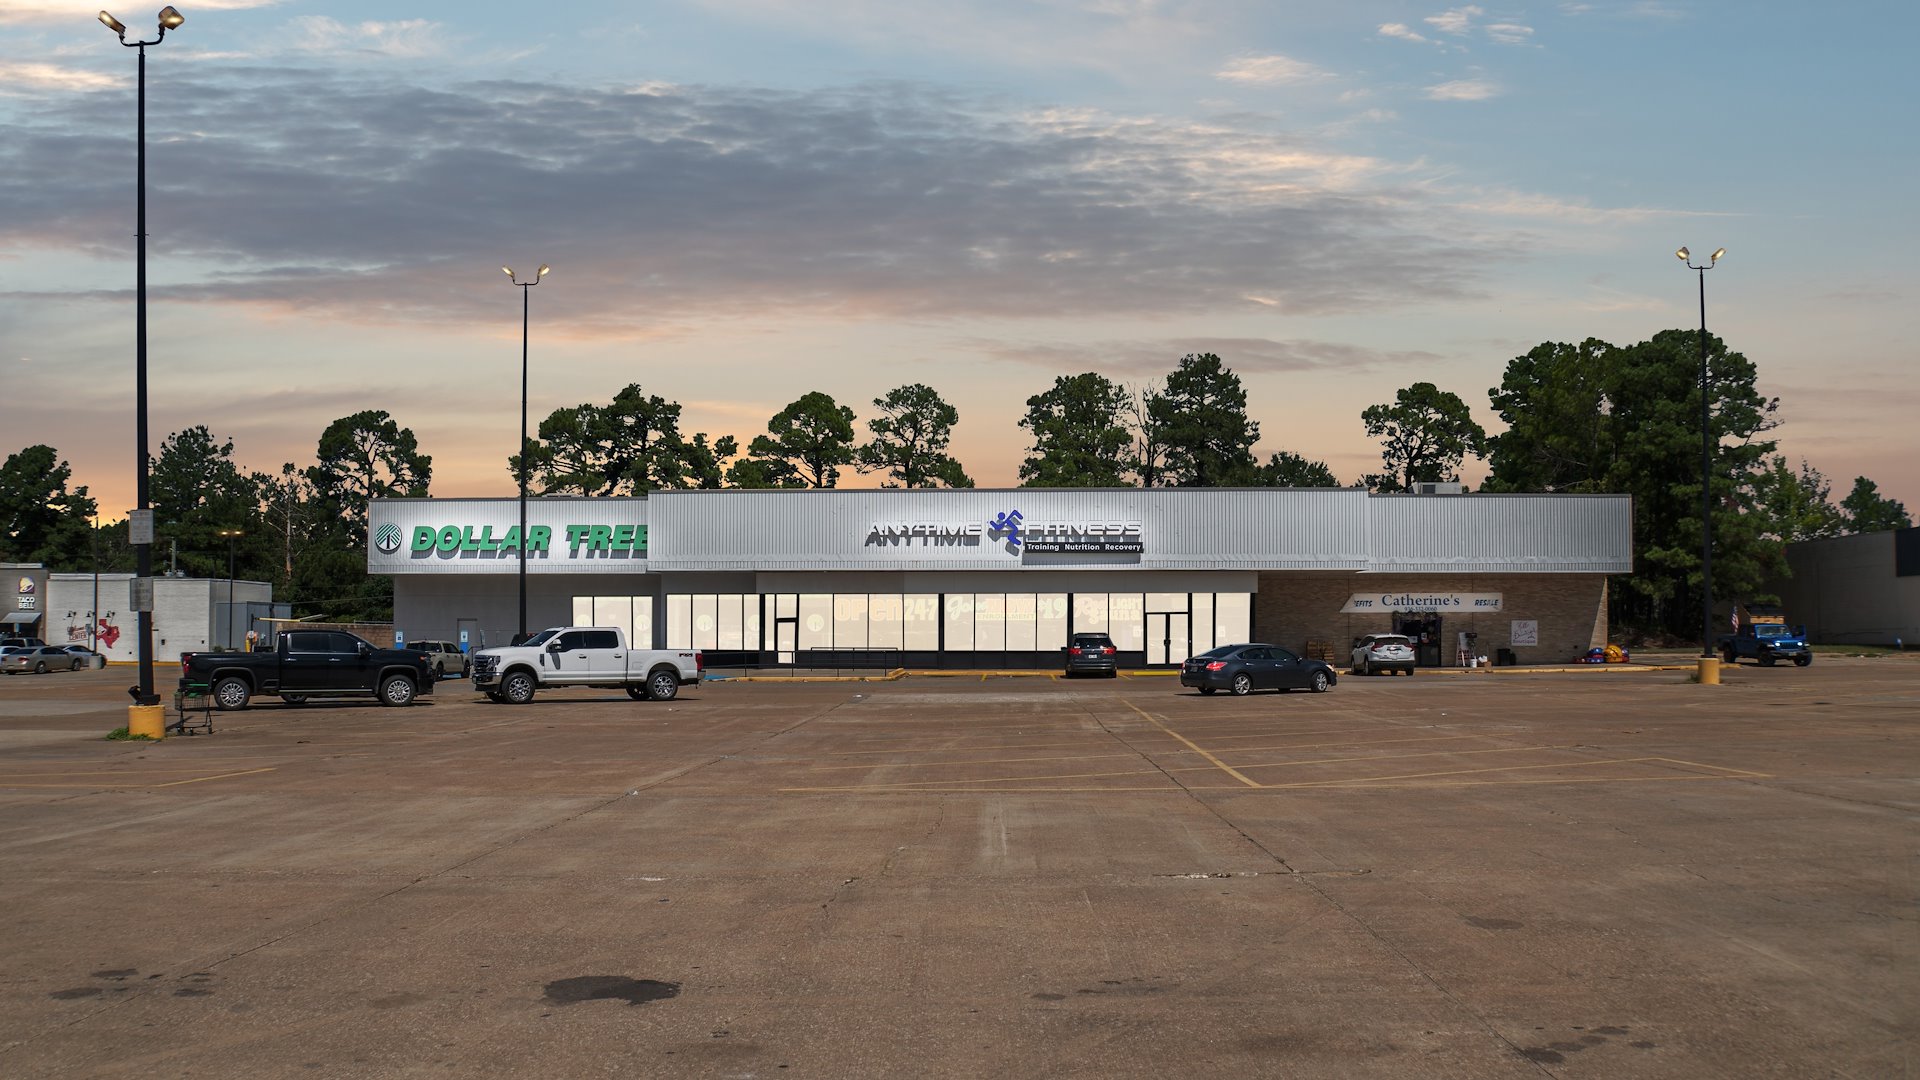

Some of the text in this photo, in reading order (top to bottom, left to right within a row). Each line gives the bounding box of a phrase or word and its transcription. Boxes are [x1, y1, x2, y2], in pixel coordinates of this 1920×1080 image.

[867, 520, 1142, 536] ANYTIME FITNESS
[411, 524, 648, 551] DOLLAR TREE
[1027, 543, 1141, 552] Training Nutrition Recovery
[1382, 594, 1461, 607] Catherine's
